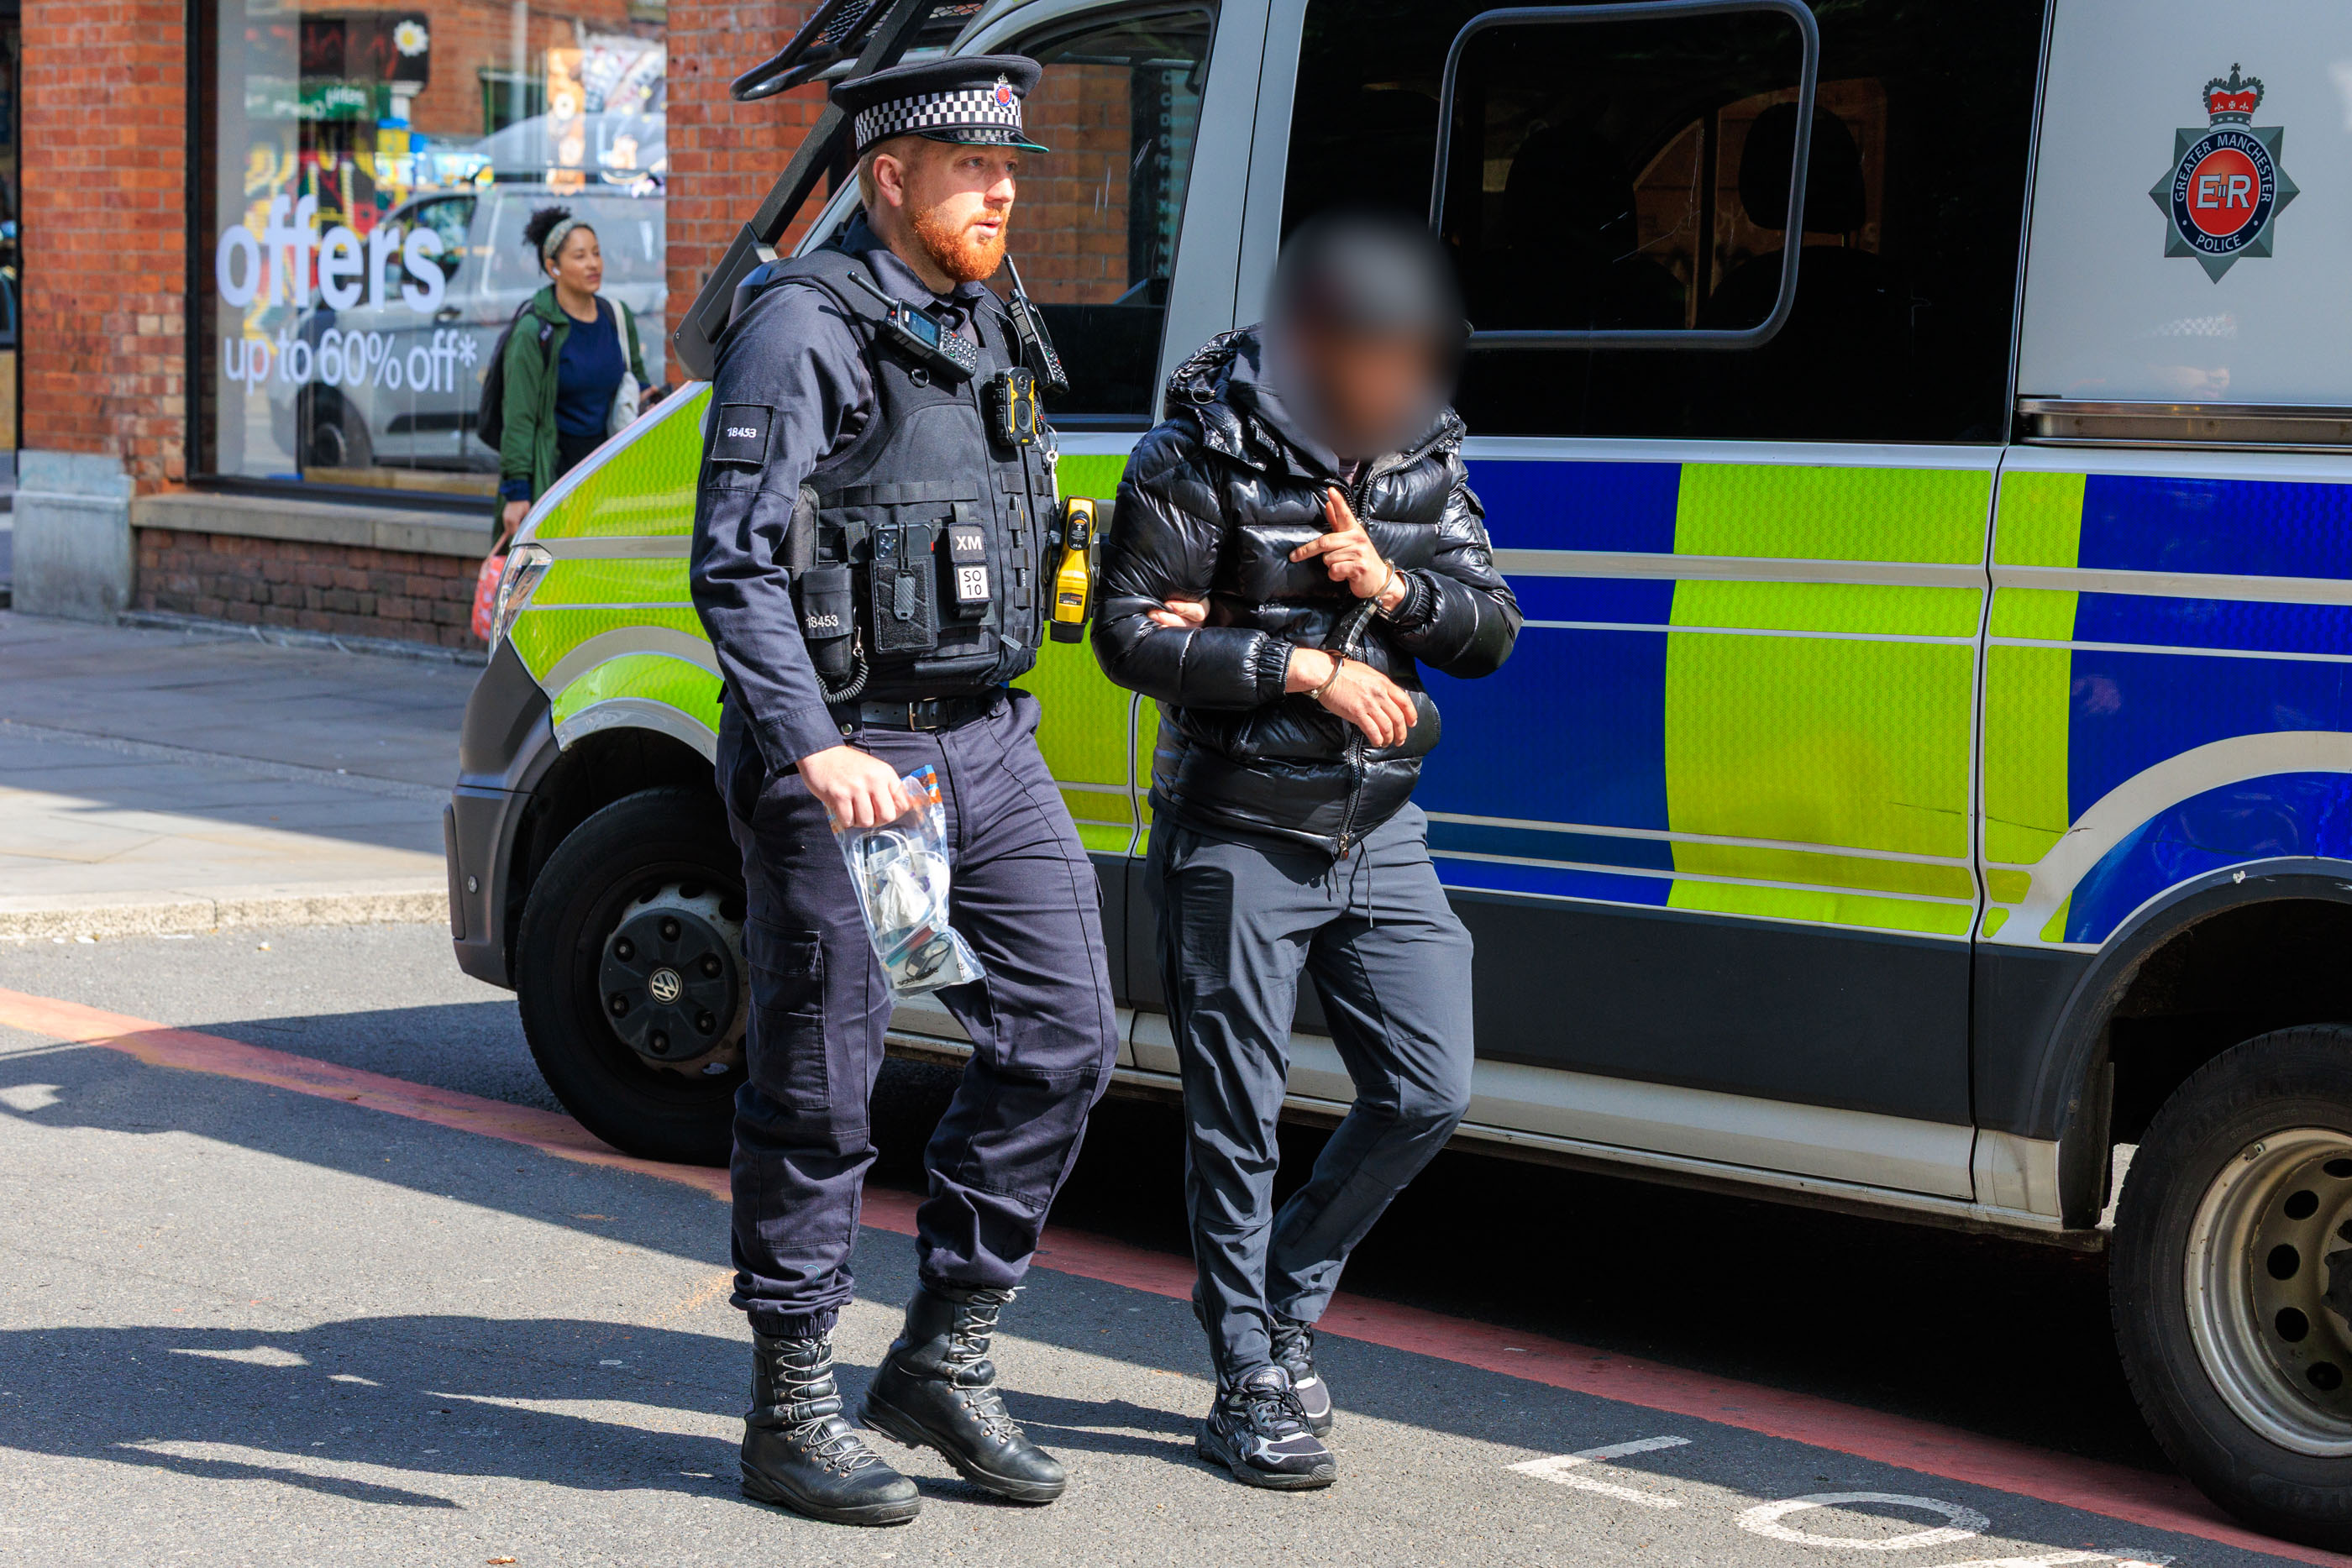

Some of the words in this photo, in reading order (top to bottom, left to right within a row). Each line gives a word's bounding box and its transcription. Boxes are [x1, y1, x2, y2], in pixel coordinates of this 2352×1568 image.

[2176, 142, 2212, 202] GREATER
[2218, 134, 2272, 202] MANCHESTER
[2196, 234, 2241, 251] POLICE
[216, 193, 445, 313] offers
[224, 338, 269, 396] up
[276, 328, 313, 384] to
[319, 328, 402, 390] 60%
[727, 427, 757, 438] 18453
[956, 536, 983, 550] XM
[966, 584, 981, 595] 10
[806, 615, 838, 628] 18453
[1508, 1435, 2176, 1568] LO
